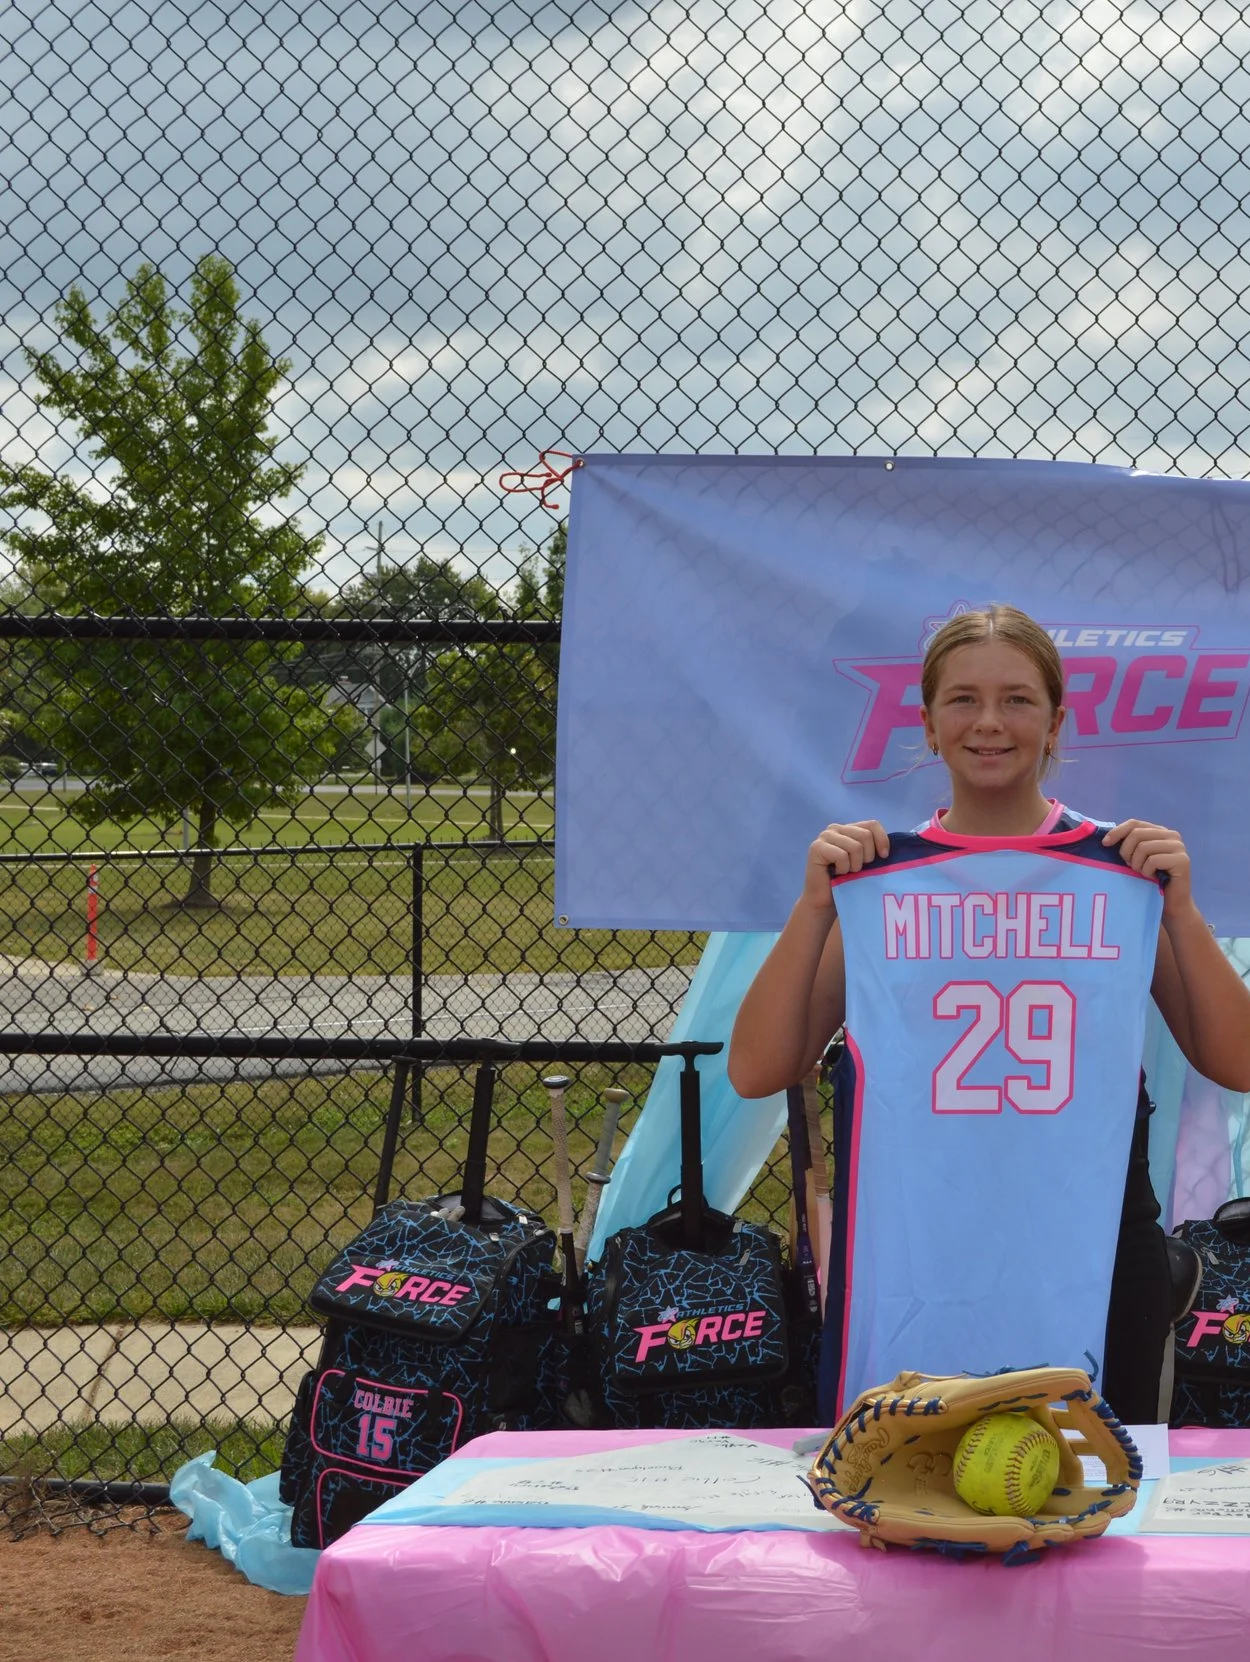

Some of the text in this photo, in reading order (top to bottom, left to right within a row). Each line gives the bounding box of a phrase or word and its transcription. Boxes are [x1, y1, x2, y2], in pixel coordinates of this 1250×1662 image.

[850, 653, 1250, 771] FRCE
[882, 892, 1121, 960] MITCHELL
[931, 980, 1077, 1115] 29
[676, 1303, 745, 1319] ATHLETICS
[353, 1388, 414, 1418] COLBIE
[355, 1413, 398, 1462] 15
